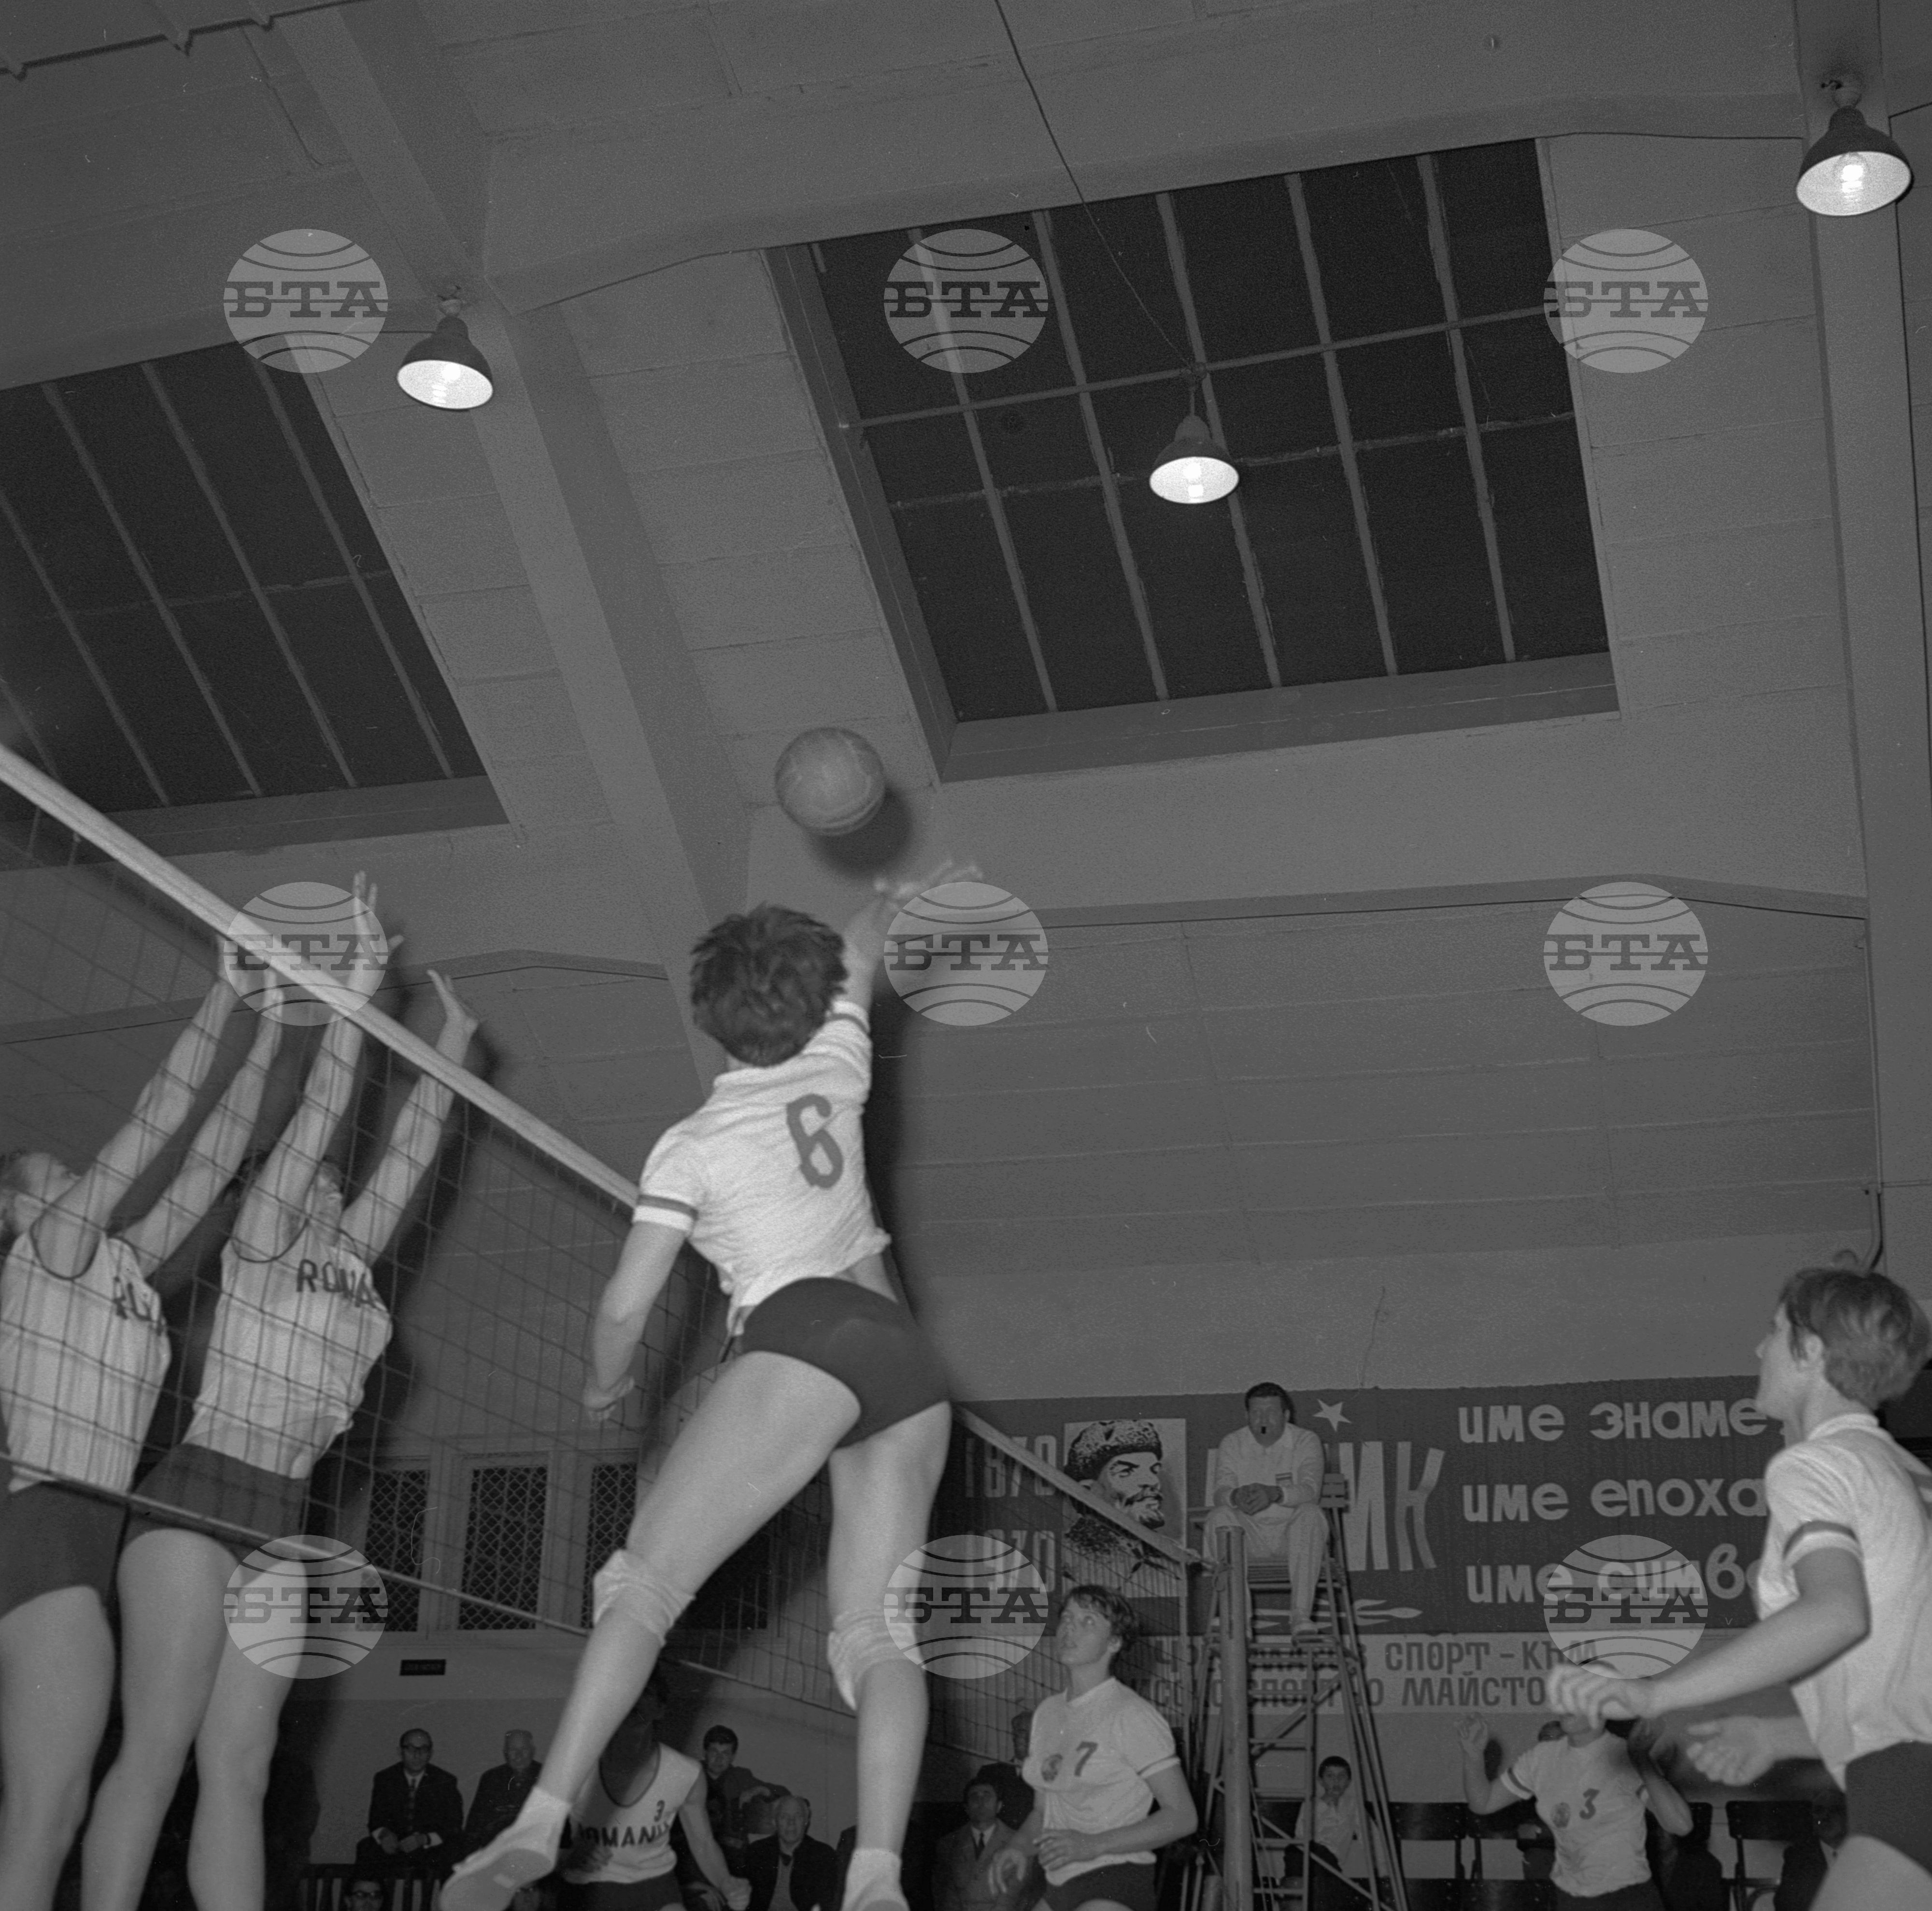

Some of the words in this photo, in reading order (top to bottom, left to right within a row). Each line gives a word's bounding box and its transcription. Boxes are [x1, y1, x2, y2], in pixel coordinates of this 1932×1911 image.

[786, 1093, 843, 1189] 6
[1458, 1404, 1565, 1443] име
[1462, 1482, 1569, 1523] име
[1590, 1477, 1769, 1517] епоха
[1466, 1562, 1573, 1603] име
[1385, 1642, 1490, 1671] СПОРТ
[1074, 1741, 1098, 1777] 7
[653, 1799, 666, 1823] 3
[1579, 1788, 1600, 1820] 3
